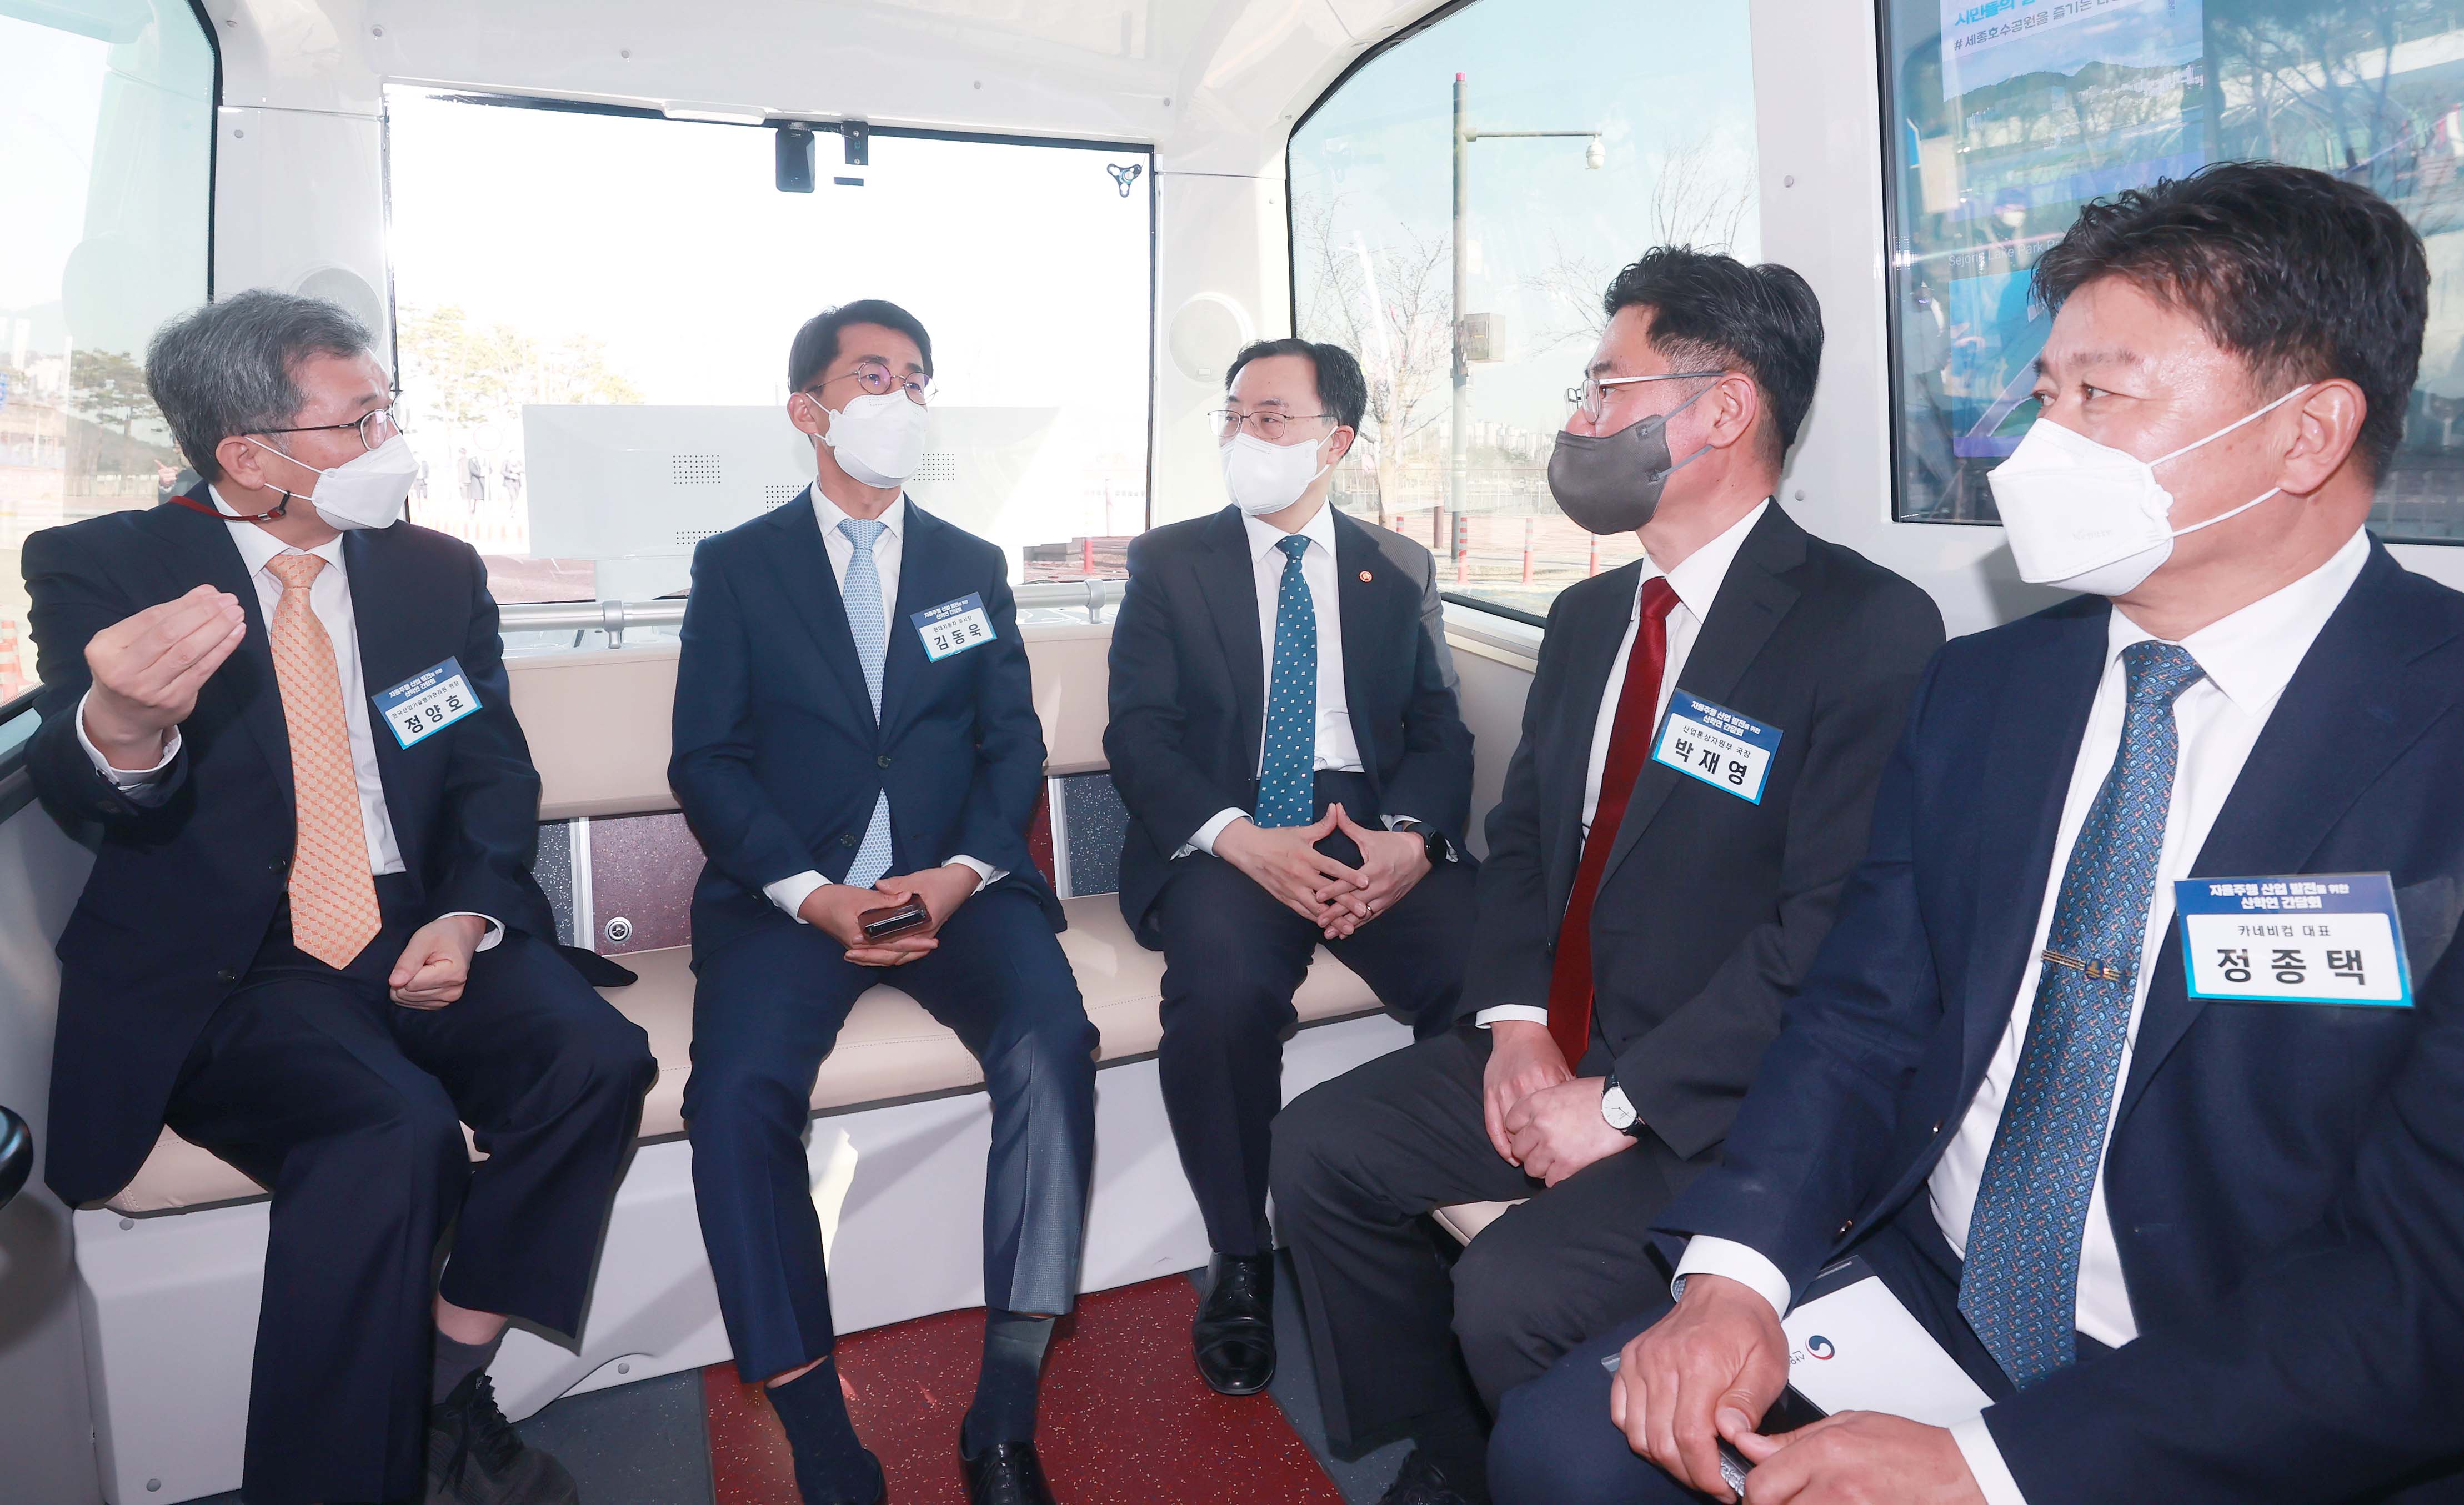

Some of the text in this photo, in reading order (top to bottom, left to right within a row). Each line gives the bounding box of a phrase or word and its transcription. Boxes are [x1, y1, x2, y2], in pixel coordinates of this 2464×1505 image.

[1988, 247, 2014, 260] Lake
[2017, 241, 2044, 255] Park
[934, 623, 982, 651] 김동욱
[449, 681, 459, 689] 원장
[404, 695, 464, 734] 정양호
[1691, 700, 1717, 716] 자율주행
[1716, 710, 1731, 723] 산업
[1750, 724, 1761, 735] 위한
[1702, 714, 1744, 737] 산학연 간담회
[1683, 725, 1751, 759] 산업통상자원부 국장
[1675, 738, 1747, 786] 박재영
[2209, 882, 2260, 897] 자율주행
[2261, 882, 2288, 895] 산업
[2329, 884, 2350, 894] 위한
[2241, 896, 2322, 910] 산학연 간담회
[2238, 925, 2331, 937] 카네비컴 대표
[2217, 948, 2366, 986] 정종택
